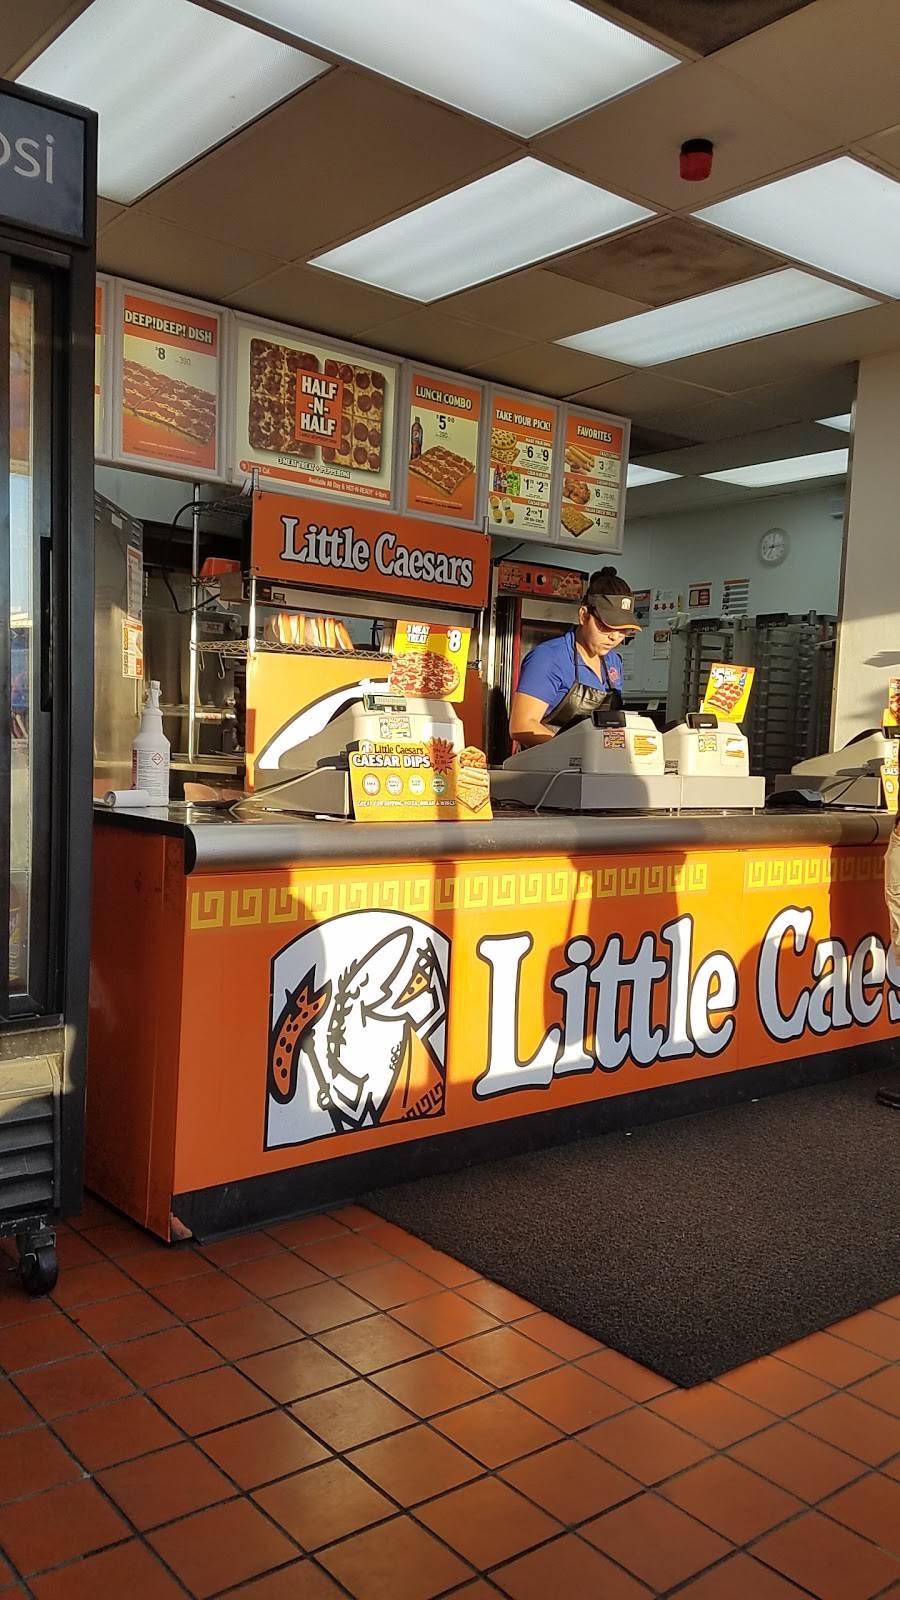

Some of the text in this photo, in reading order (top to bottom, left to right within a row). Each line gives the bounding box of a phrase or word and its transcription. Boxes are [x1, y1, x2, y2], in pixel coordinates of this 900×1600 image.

[188, 326, 213, 344] DISH
[301, 374, 338, 400] HALF
[415, 385, 472, 410] LUNCH COMBO
[307, 396, 330, 416] -N-
[300, 412, 337, 436] HALF
[495, 409, 552, 431] TAKE YOUR PICK!
[577, 425, 613, 443] FAVORITES
[280, 515, 473, 588] Little Caesars
[374, 743, 424, 755] Little Caesars
[352, 753, 401, 768] CAESAR
[403, 755, 431, 768] DIPS
[473, 913, 739, 1100] Little
